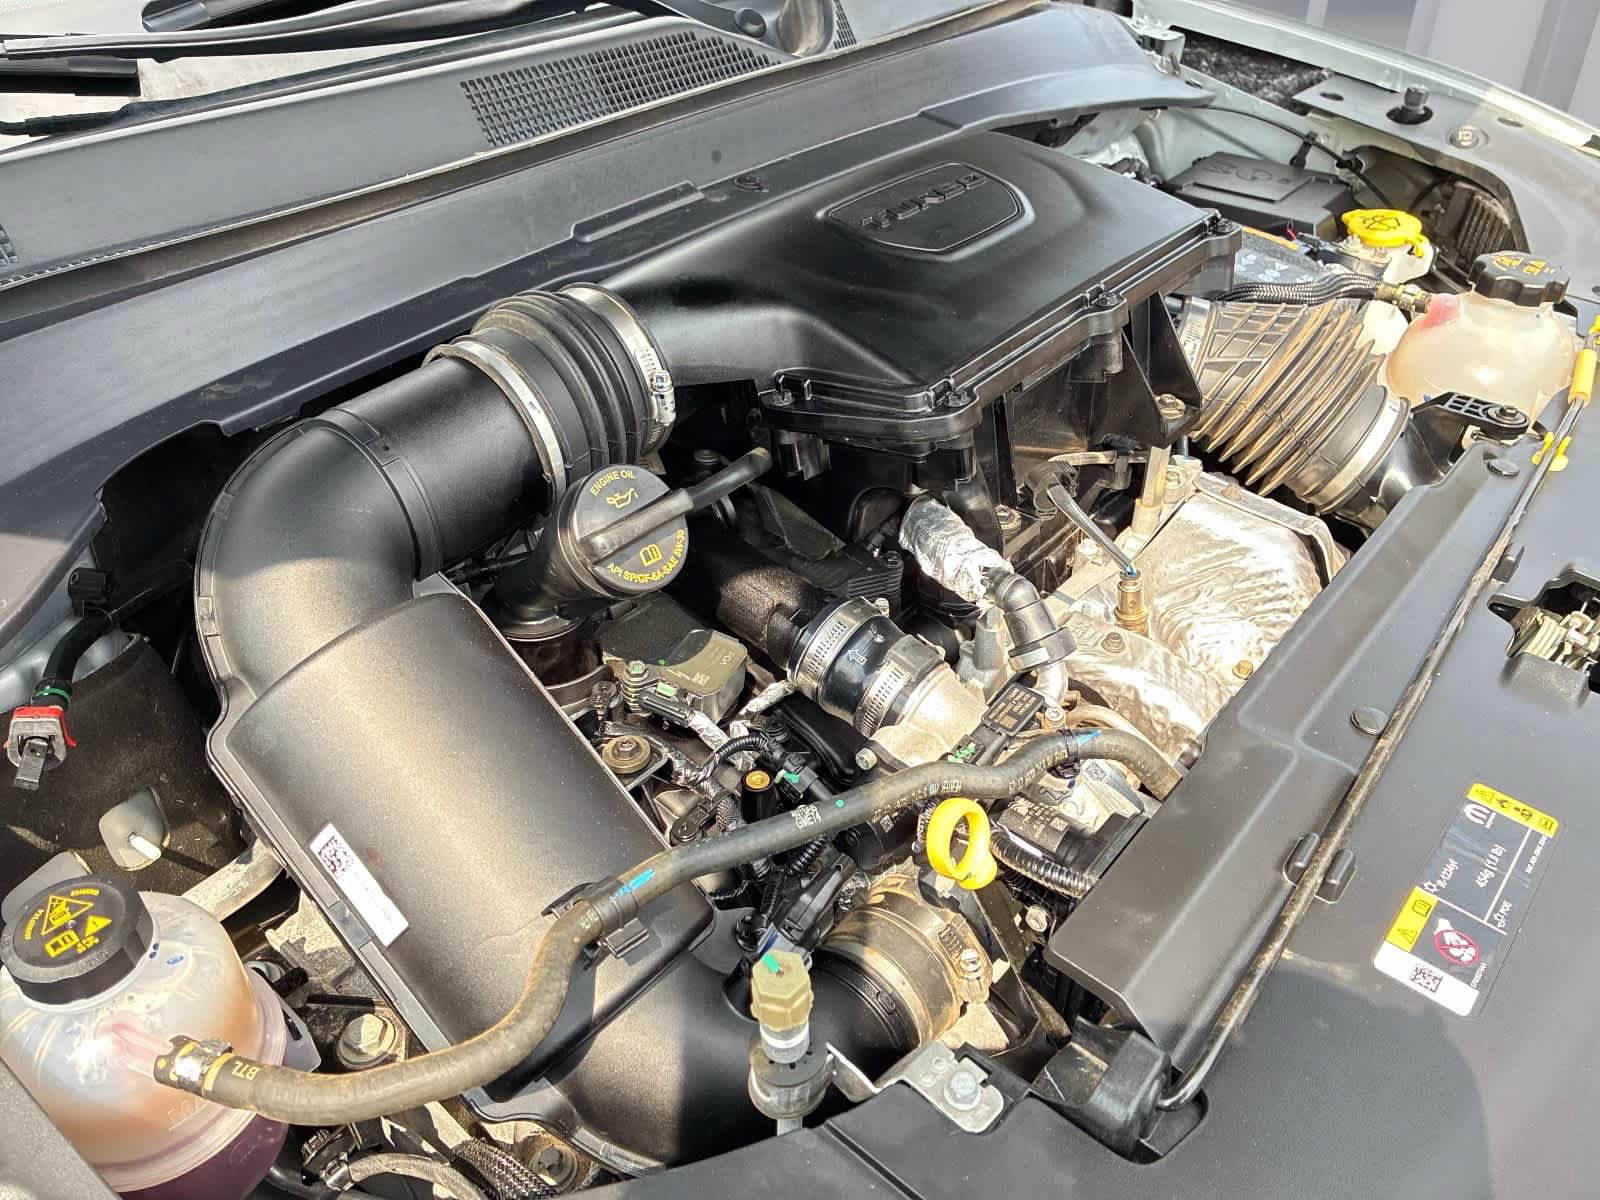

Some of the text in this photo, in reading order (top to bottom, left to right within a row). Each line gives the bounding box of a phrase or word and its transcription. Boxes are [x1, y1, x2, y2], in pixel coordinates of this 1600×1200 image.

[861, 173, 987, 228] TURBO
[590, 470, 637, 496] ENGINE OIL
[607, 562, 623, 577] API
[674, 529, 685, 558] 5W-30
[1475, 868, 1495, 888] 454g
[231, 1061, 259, 1080] BTL
